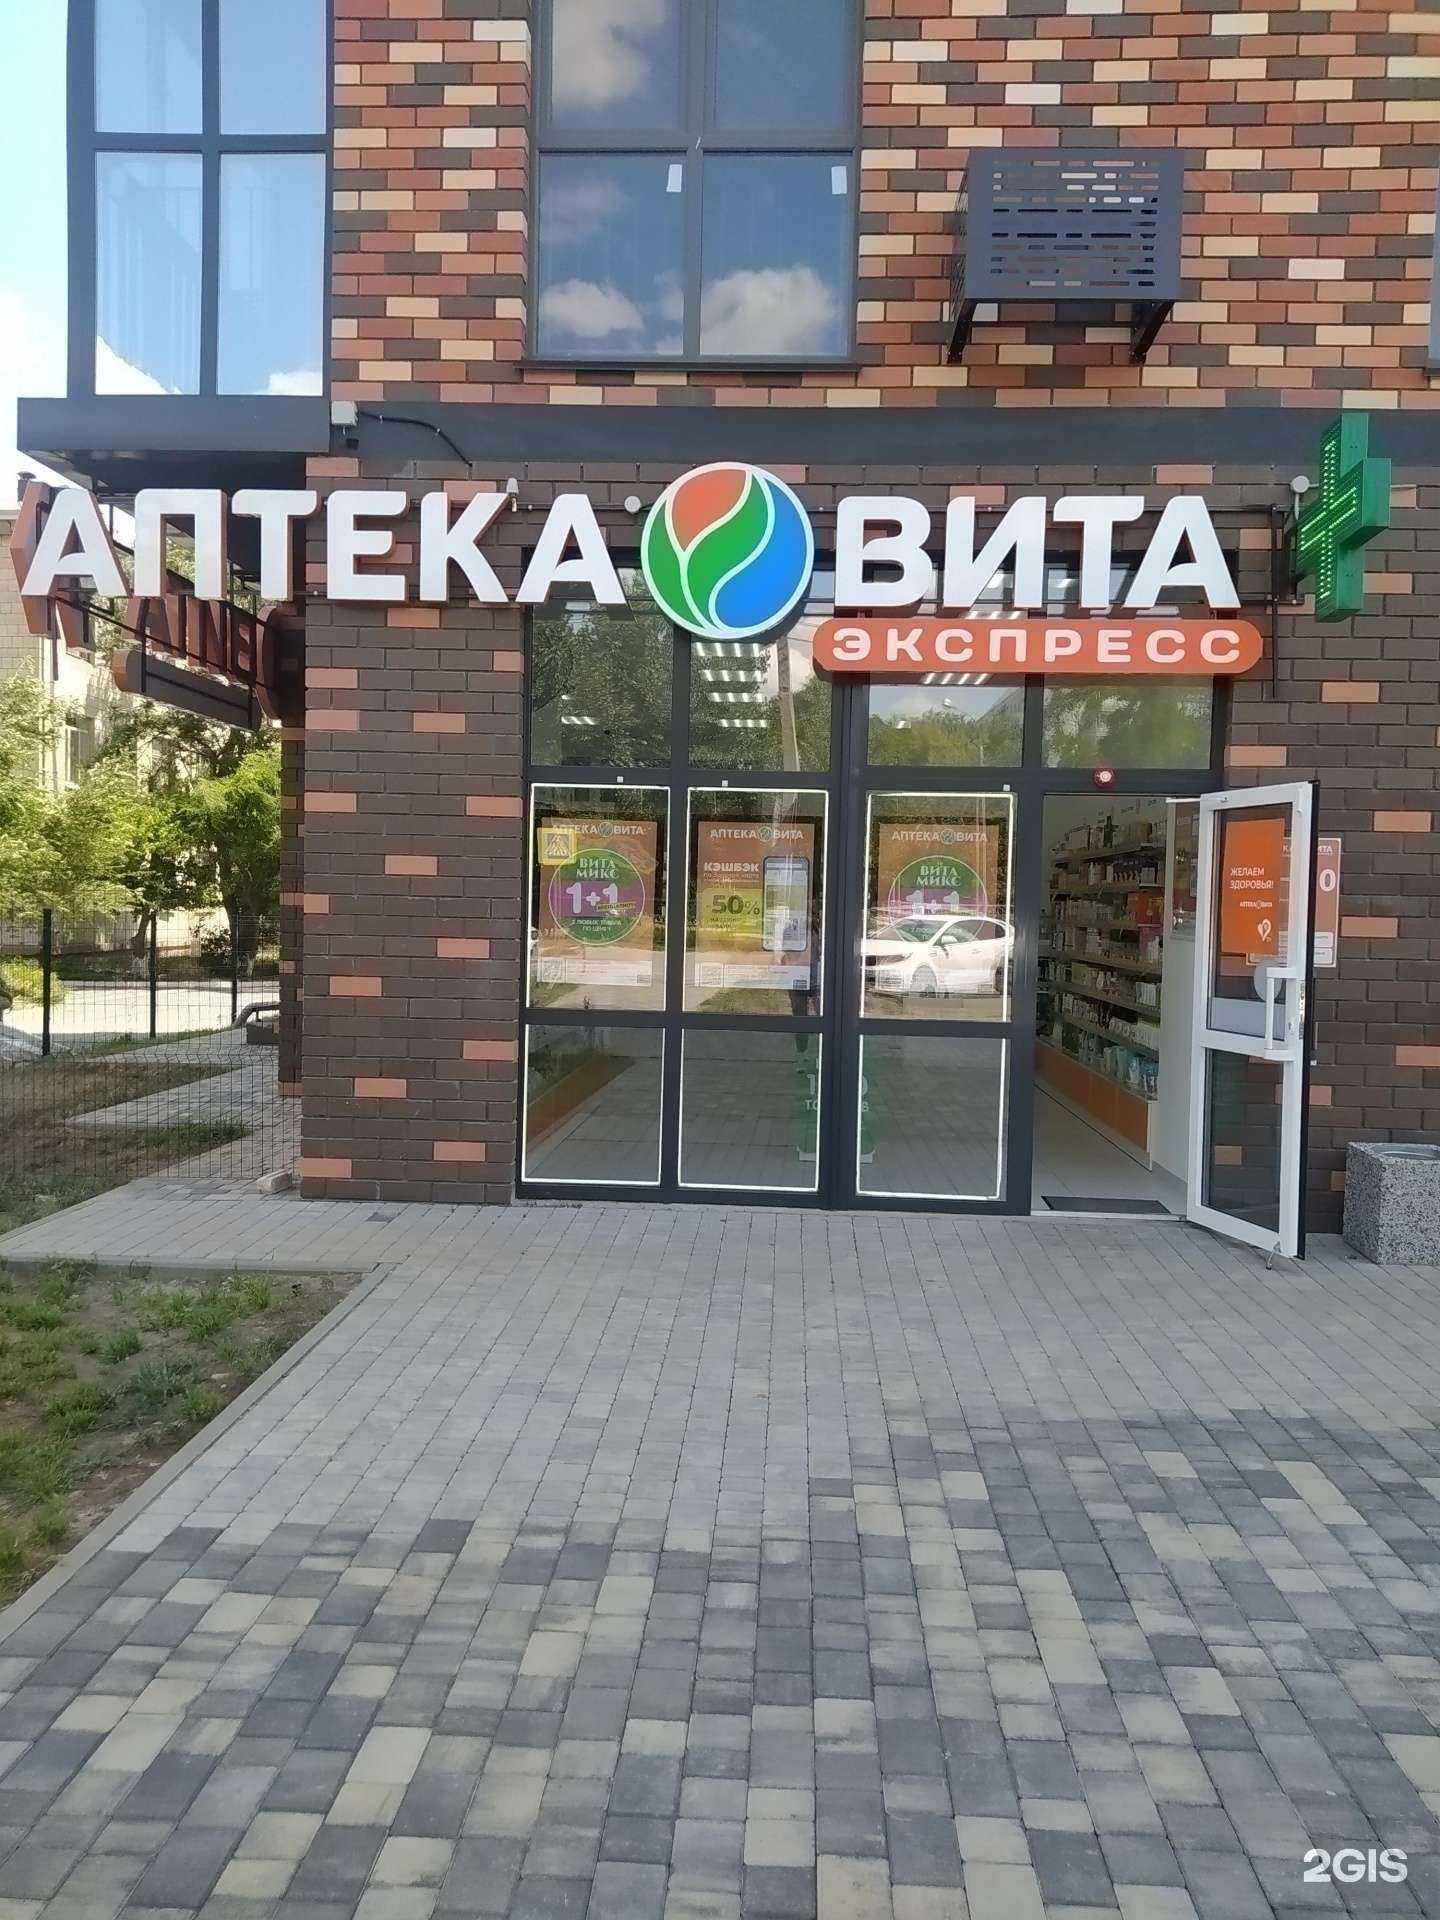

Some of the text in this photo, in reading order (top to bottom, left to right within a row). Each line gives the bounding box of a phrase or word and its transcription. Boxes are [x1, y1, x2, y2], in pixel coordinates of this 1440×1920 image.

[20, 488, 1242, 610] АПТЕКА ВИТА
[832, 627, 1241, 664] ЭКСПРЕСС
[613, 825, 644, 836] ВИТА
[710, 829, 805, 841] АПТЕКА ВИТА
[891, 831, 988, 843] АПТЕКА ВИТА
[579, 858, 616, 869] ВИТА
[703, 862, 760, 872] КЭШБЭК
[576, 868, 620, 879] МИКС
[920, 866, 958, 876] ВИТА
[1230, 867, 1265, 877] ЖЕЛАЕМ
[917, 876, 961, 887] МИКС
[1229, 879, 1275, 890] ЗДОРОВЬЯ!
[565, 882, 619, 914] 1+1
